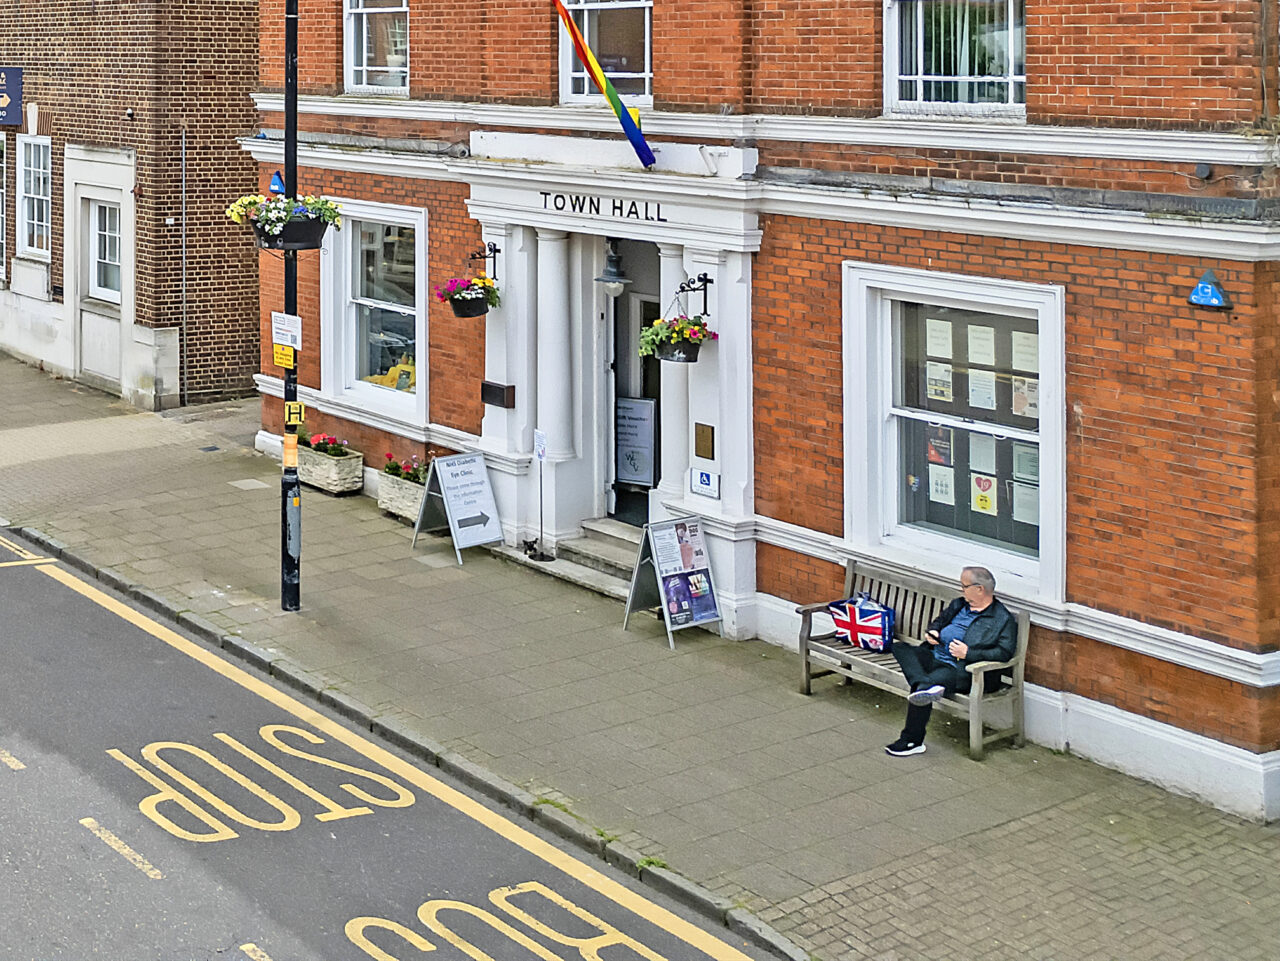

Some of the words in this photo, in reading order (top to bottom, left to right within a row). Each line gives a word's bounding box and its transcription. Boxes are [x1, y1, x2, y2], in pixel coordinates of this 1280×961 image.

[540, 191, 601, 215] TOWN
[612, 198, 668, 223] HALL
[288, 404, 302, 422] H
[105, 724, 416, 842] STOP
